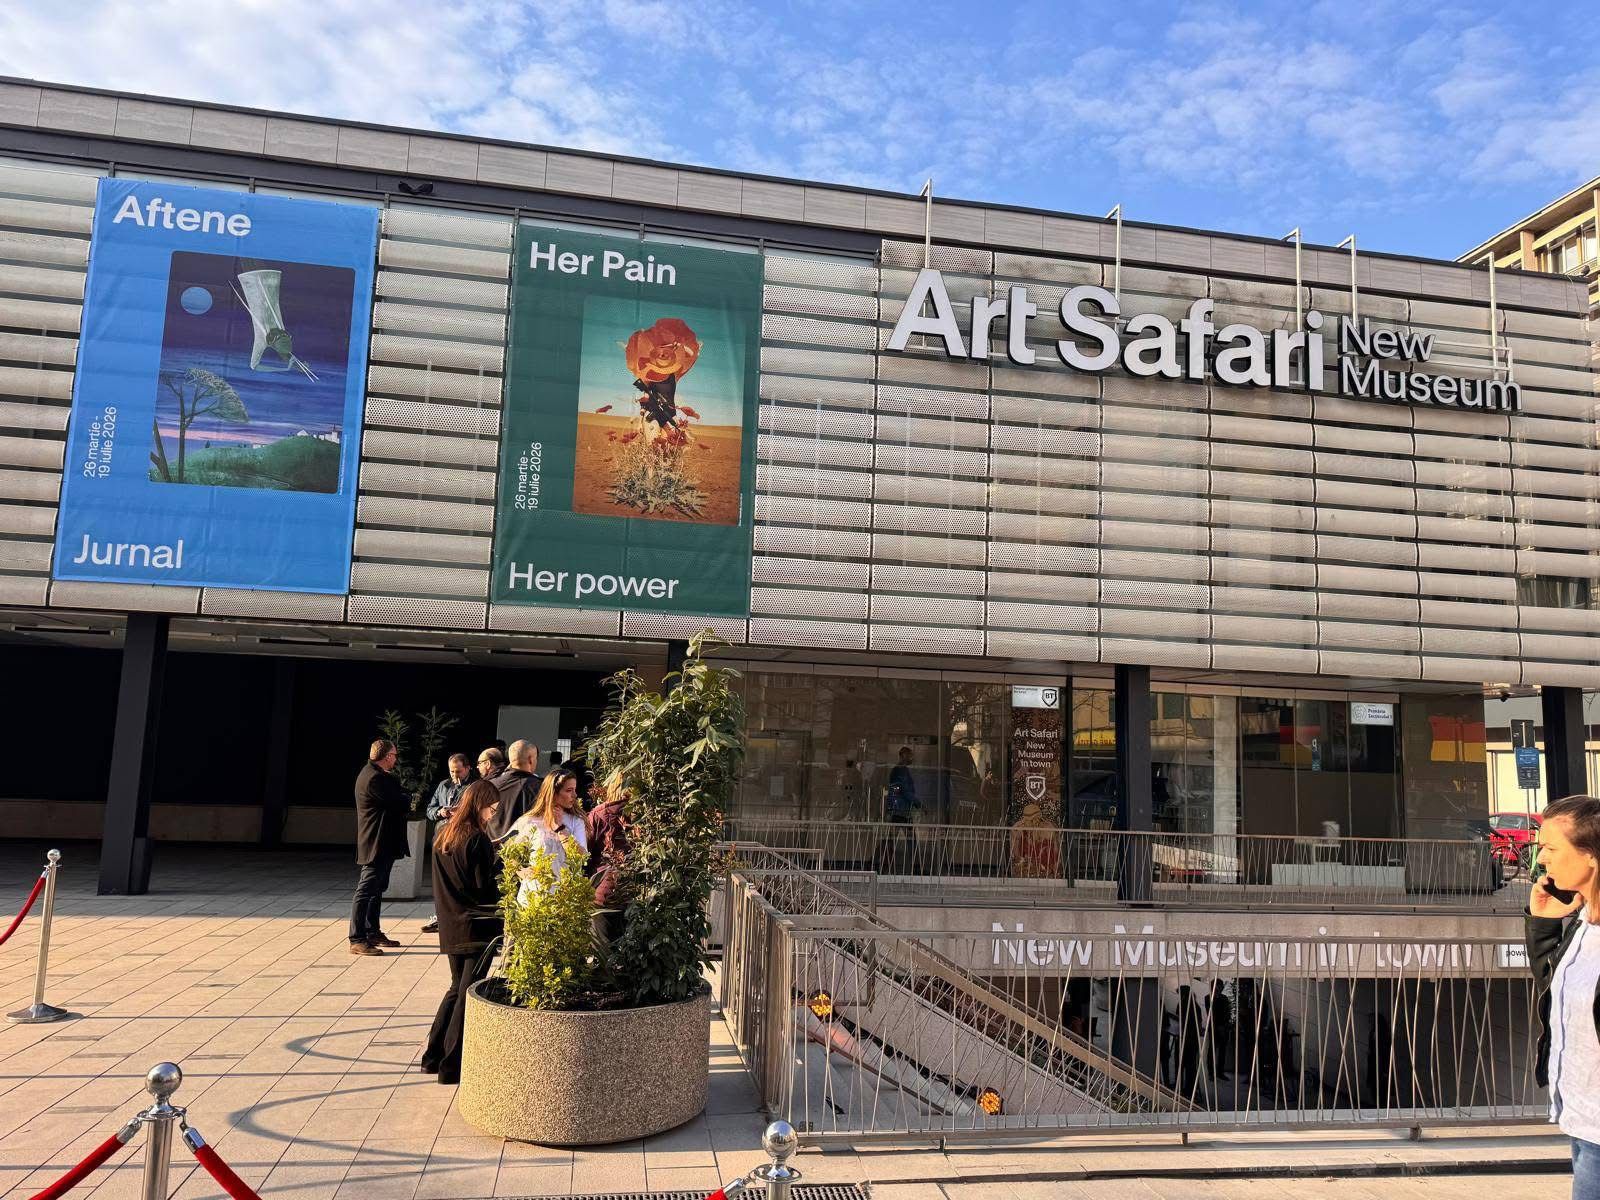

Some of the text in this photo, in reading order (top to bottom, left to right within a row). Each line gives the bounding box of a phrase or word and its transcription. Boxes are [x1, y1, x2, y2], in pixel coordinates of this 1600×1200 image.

[112, 195, 252, 237] Aftene
[529, 241, 676, 286] Her Pain
[886, 268, 1324, 391] Art Safari
[1339, 315, 1436, 361] New
[1339, 356, 1522, 411] Museum
[98, 406, 117, 478] 19 iulie 2026
[84, 461, 97, 478] 26
[528, 442, 542, 510] 19 iulie 2026
[515, 494, 526, 509] 26
[73, 534, 183, 569] Jurnal
[509, 561, 679, 599] Her power
[1014, 728, 1058, 738] Art Safari
[1026, 741, 1046, 750] New
[1018, 750, 1054, 759] Museum
[1020, 759, 1051, 768] in town
[1030, 781, 1043, 789] BT
[992, 922, 1473, 968] New Museum in town
[1505, 950, 1527, 958] powe
